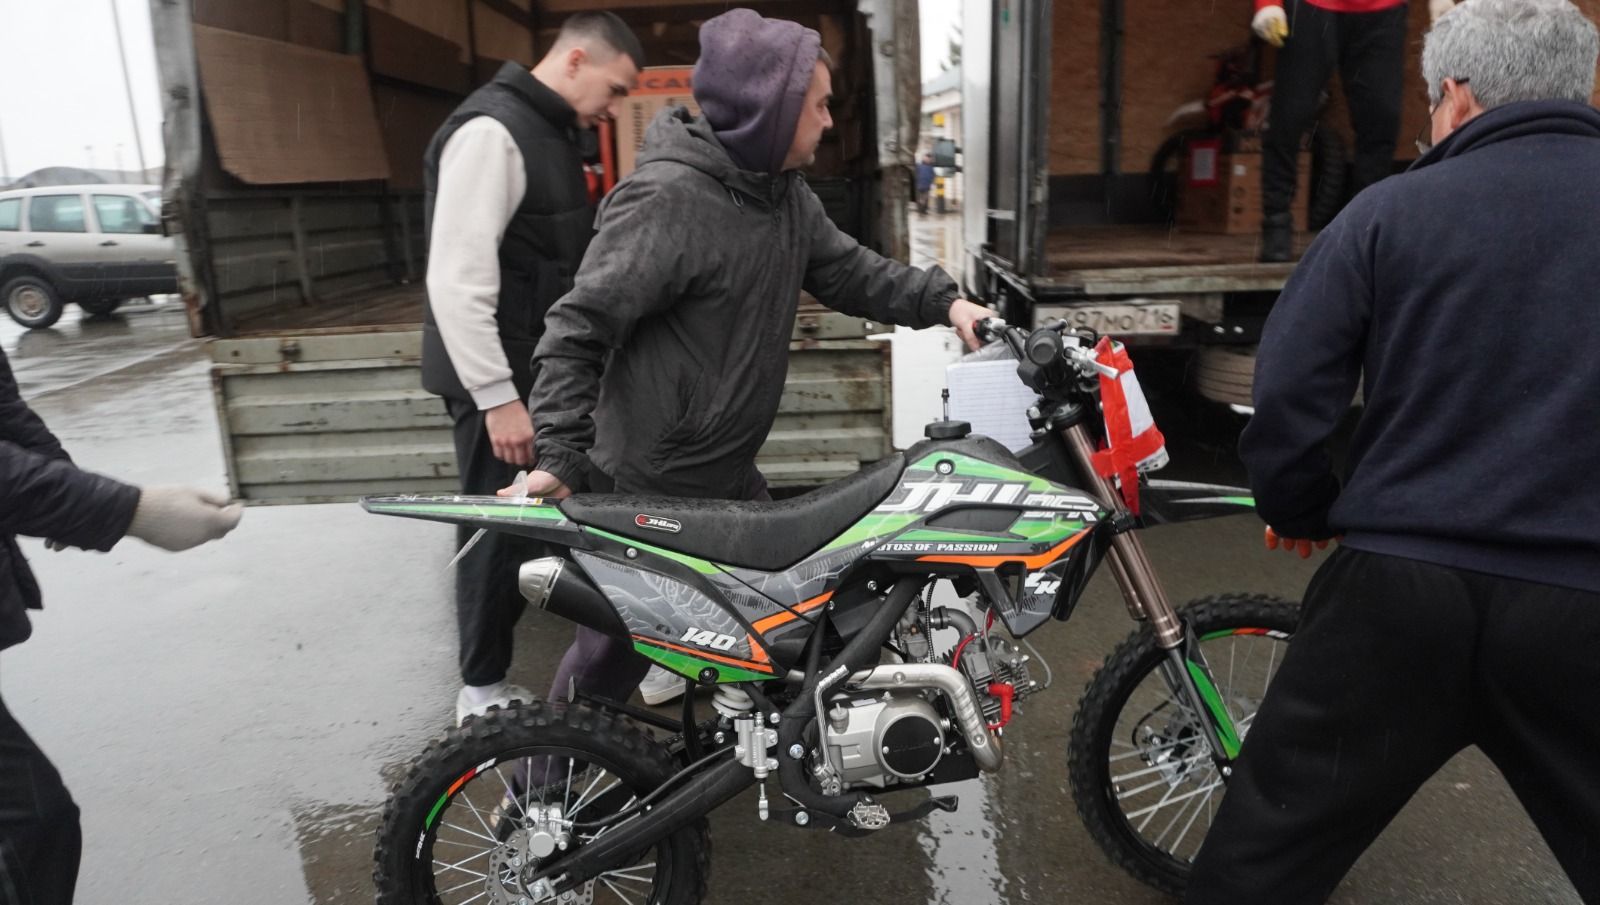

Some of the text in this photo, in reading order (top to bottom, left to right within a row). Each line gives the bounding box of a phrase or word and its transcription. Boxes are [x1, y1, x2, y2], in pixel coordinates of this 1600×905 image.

[915, 543, 934, 551] OF
[937, 543, 998, 552] PASSION
[679, 626, 737, 651] 140
